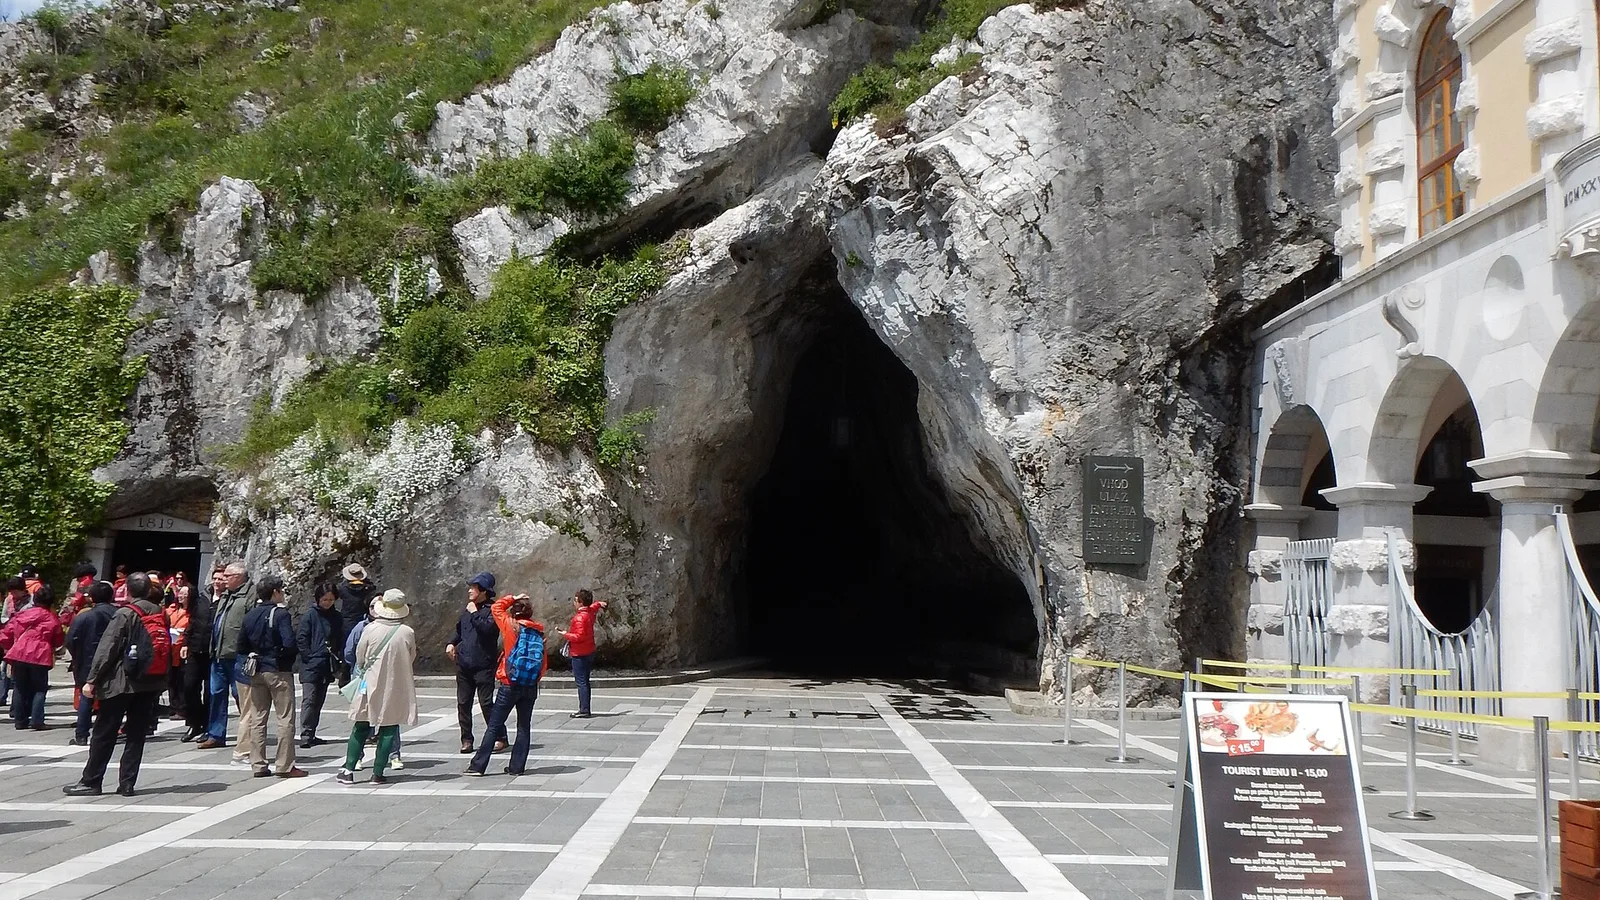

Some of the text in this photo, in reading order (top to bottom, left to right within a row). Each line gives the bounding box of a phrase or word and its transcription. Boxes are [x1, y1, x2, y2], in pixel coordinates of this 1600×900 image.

[1099, 478, 1129, 489] VHOD
[1099, 491, 1129, 502] ULAZ
[1089, 504, 1137, 516] ENTRATA
[138, 517, 174, 530] 1819
[1088, 517, 1138, 529] EINTRITT
[1085, 530, 1142, 542] ENTRANCE
[1229, 744, 1237, 754] €
[1221, 765, 1261, 776] TOURIST
[1262, 767, 1289, 777] MENU
[1291, 768, 1298, 777] II
[1304, 768, 1328, 778] 15,00
